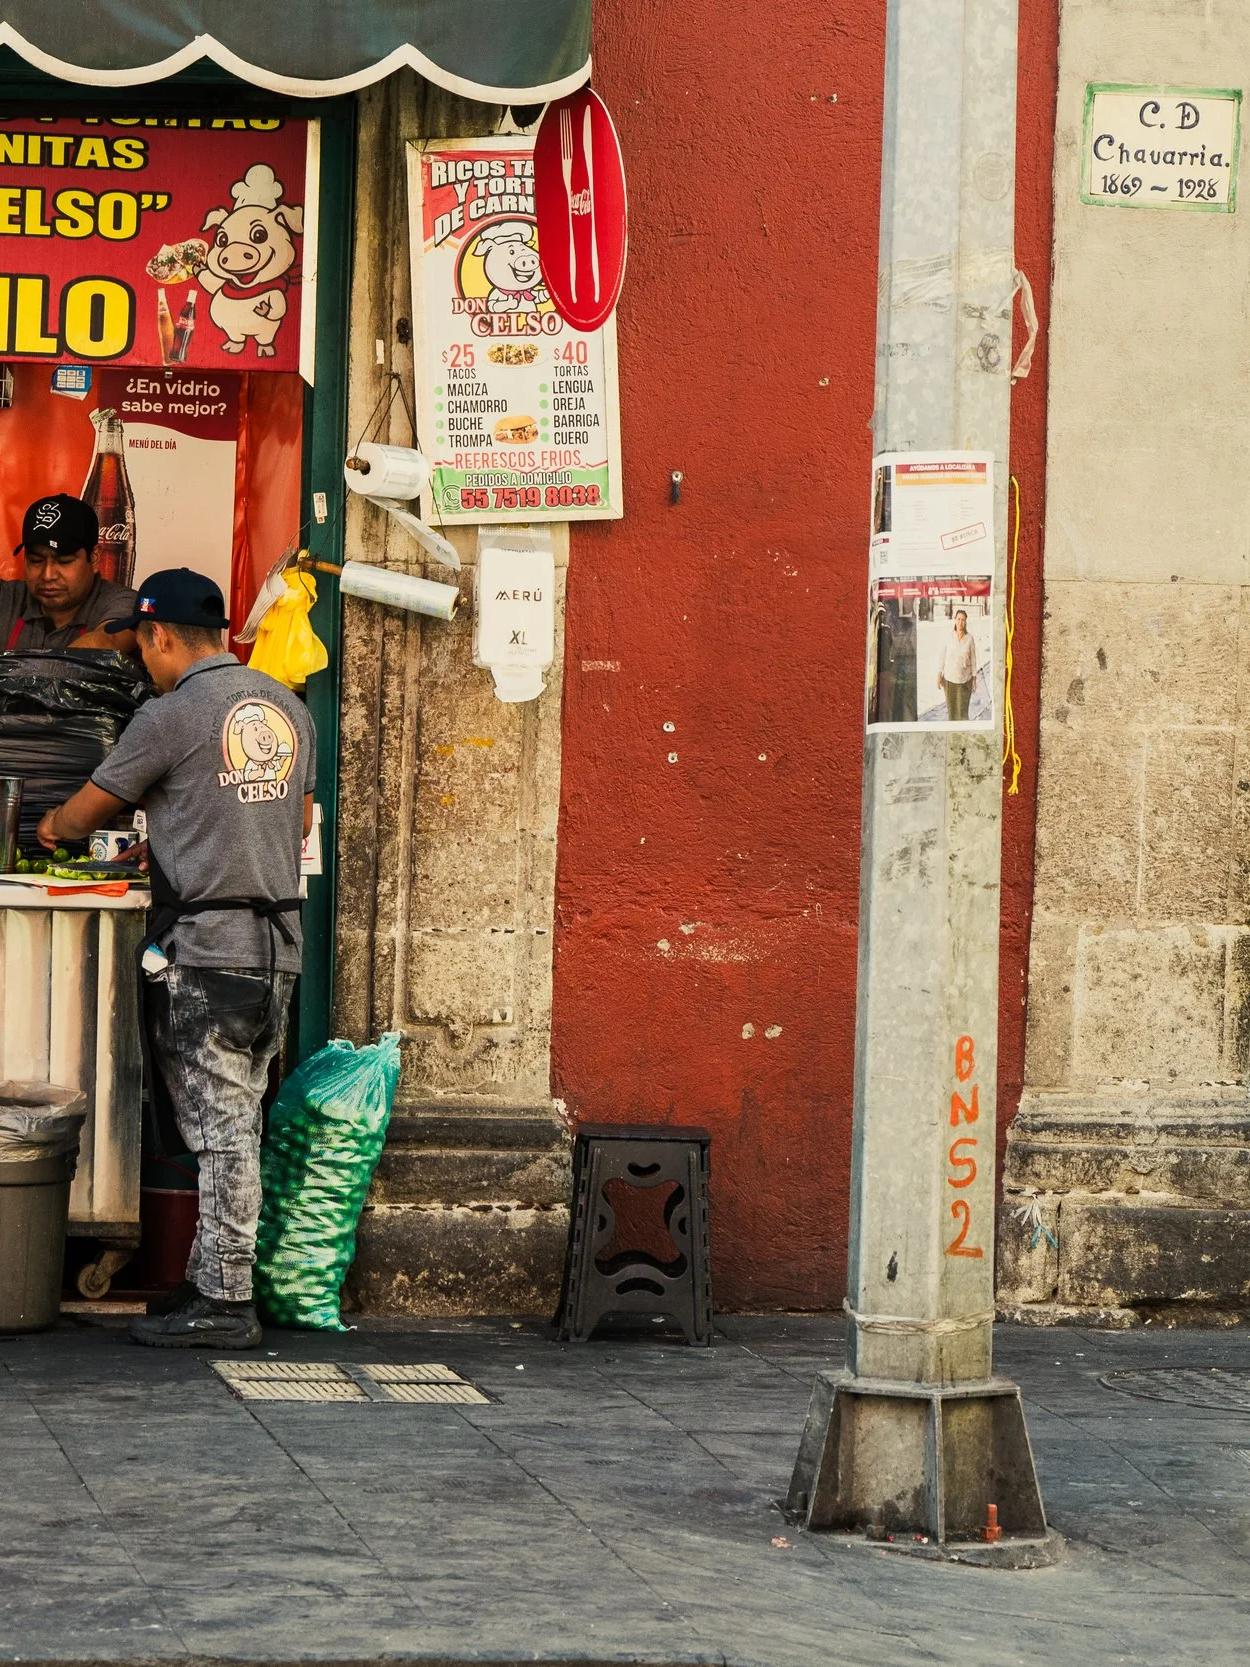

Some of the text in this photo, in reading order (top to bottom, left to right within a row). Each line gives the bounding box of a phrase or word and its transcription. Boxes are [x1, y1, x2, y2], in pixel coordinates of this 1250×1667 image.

[431, 159, 507, 189] RICOS
[453, 177, 535, 204] Y TORT
[1101, 173, 1143, 197] 1869
[1177, 177, 1221, 201] 1928
[433, 194, 536, 248] DE CARN
[452, 297, 487, 314] DON
[470, 311, 564, 337] CELSO
[442, 343, 475, 368] $25
[553, 340, 588, 365] $40
[447, 368, 477, 380] TACOS
[553, 365, 589, 377] TORTAS
[126, 378, 221, 397] ¿En vidrio
[447, 382, 489, 397] MACIZA
[552, 380, 594, 394] LENGUA
[121, 399, 227, 418] sabe mejor?
[448, 399, 508, 414] CHAMORRO
[553, 397, 586, 411] OREJA
[448, 417, 484, 431] BUCHE
[553, 414, 600, 428] BARRIGA
[128, 437, 177, 450] MENÚ DEL DÍA
[448, 434, 493, 448] TROMPA
[554, 431, 589, 445] CUERO
[454, 450, 582, 470] REFRESCOS FRIOS
[465, 471, 572, 487] PEDIDOS A DOMICILIO
[460, 484, 600, 509] 55 7519 8038
[495, 588, 543, 602] MERÚ
[509, 630, 528, 645] XL
[226, 689, 259, 704] TORTAS
[260, 689, 273, 700] DE
[217, 769, 245, 787] DON
[237, 780, 289, 804] CELSO
